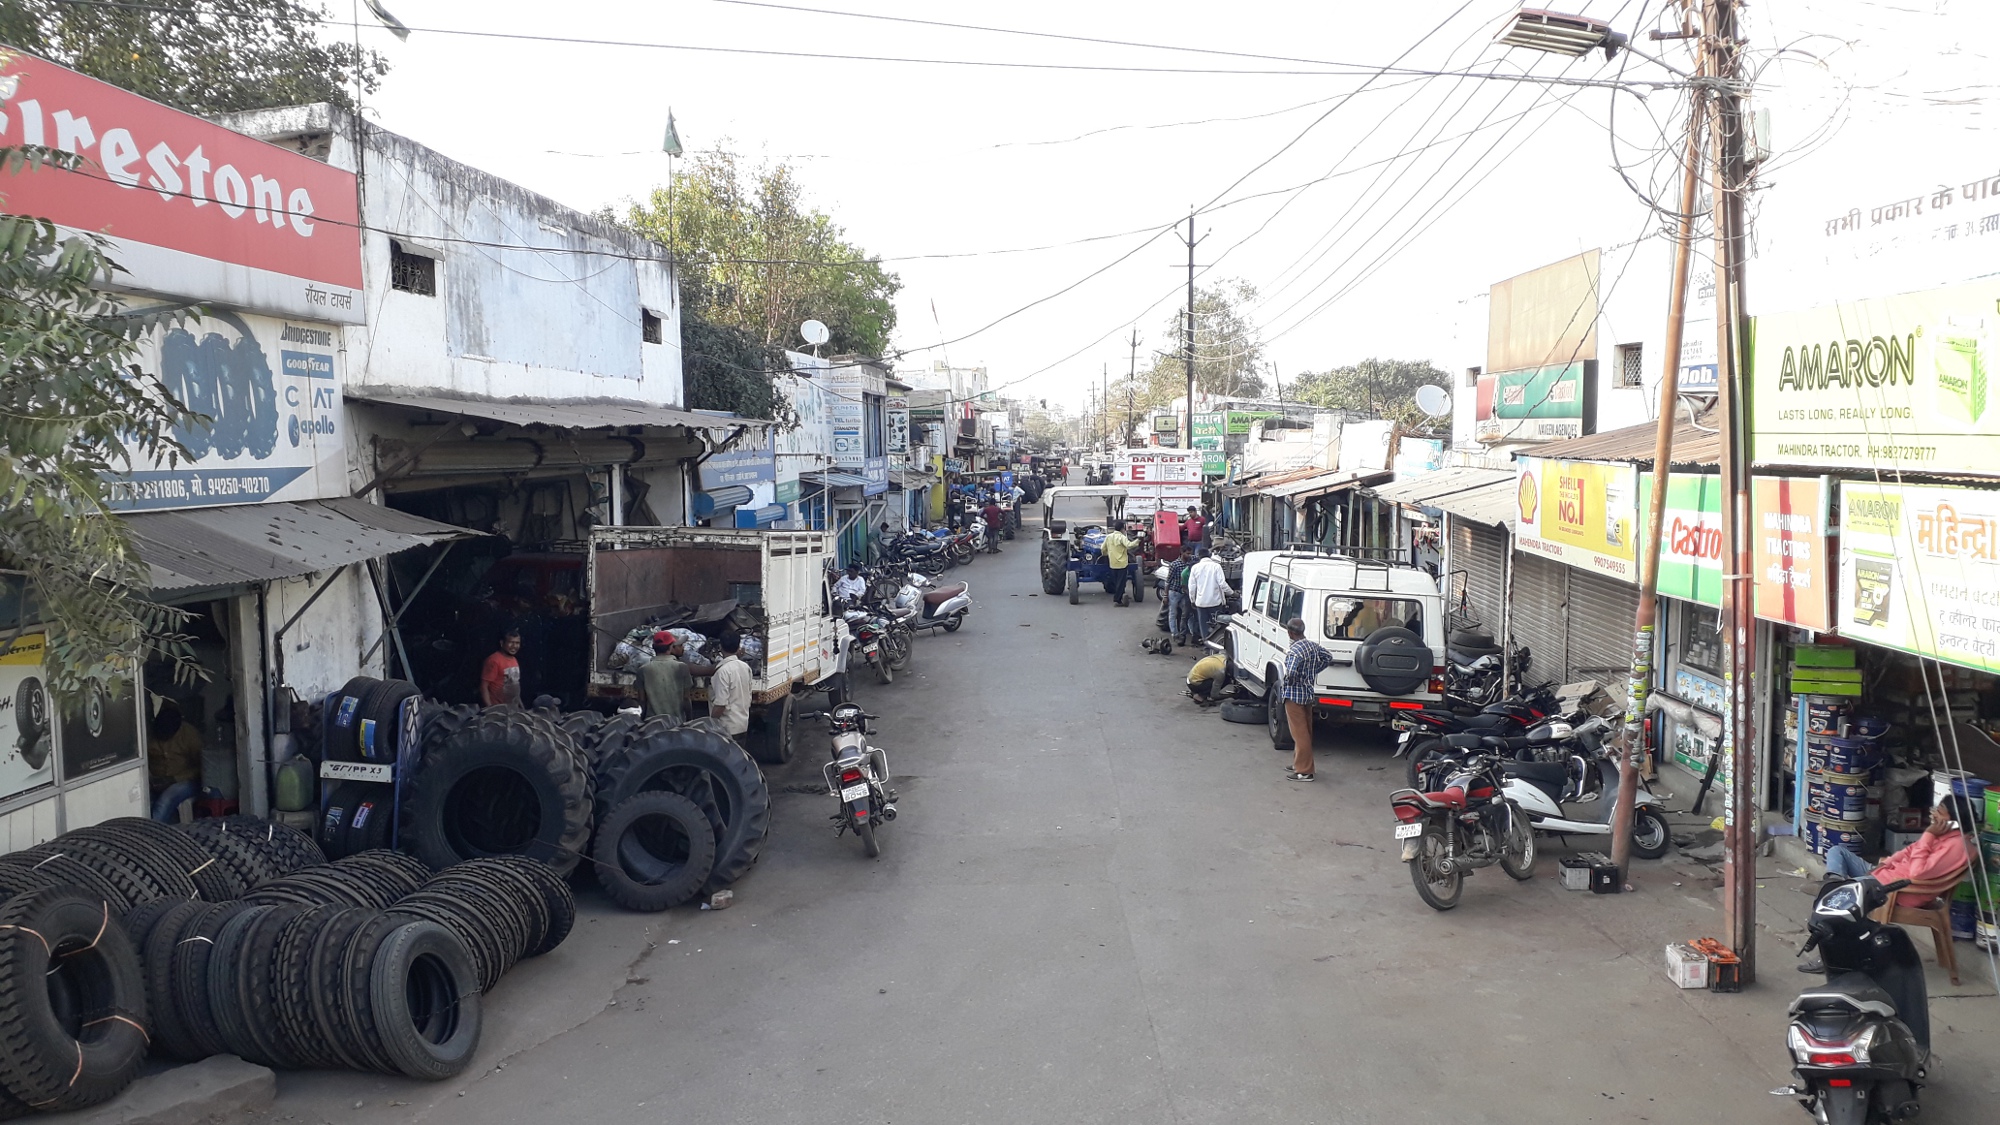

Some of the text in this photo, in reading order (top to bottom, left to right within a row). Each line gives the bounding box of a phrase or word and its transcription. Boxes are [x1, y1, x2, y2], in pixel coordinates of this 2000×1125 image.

[0, 75, 315, 237] irestone
[1931, 184, 1956, 211] के
[304, 284, 327, 306] रॉयल
[280, 321, 332, 347] BRIDGESTONE
[286, 357, 330, 372] GOODYEAR
[1778, 332, 1915, 392] AMARON
[1778, 409, 1805, 420] LASTS
[1839, 407, 1876, 420] REALLY
[300, 413, 335, 441] apollo
[1202, 454, 1225, 463] ARON
[1777, 443, 1818, 456] MAHINDRA
[1131, 464, 1146, 481] E
[1559, 475, 1577, 491] SHELL
[208, 476, 270, 495] 94250-40270
[1848, 499, 1900, 520] AMARON
[1671, 515, 1724, 561] Castro
